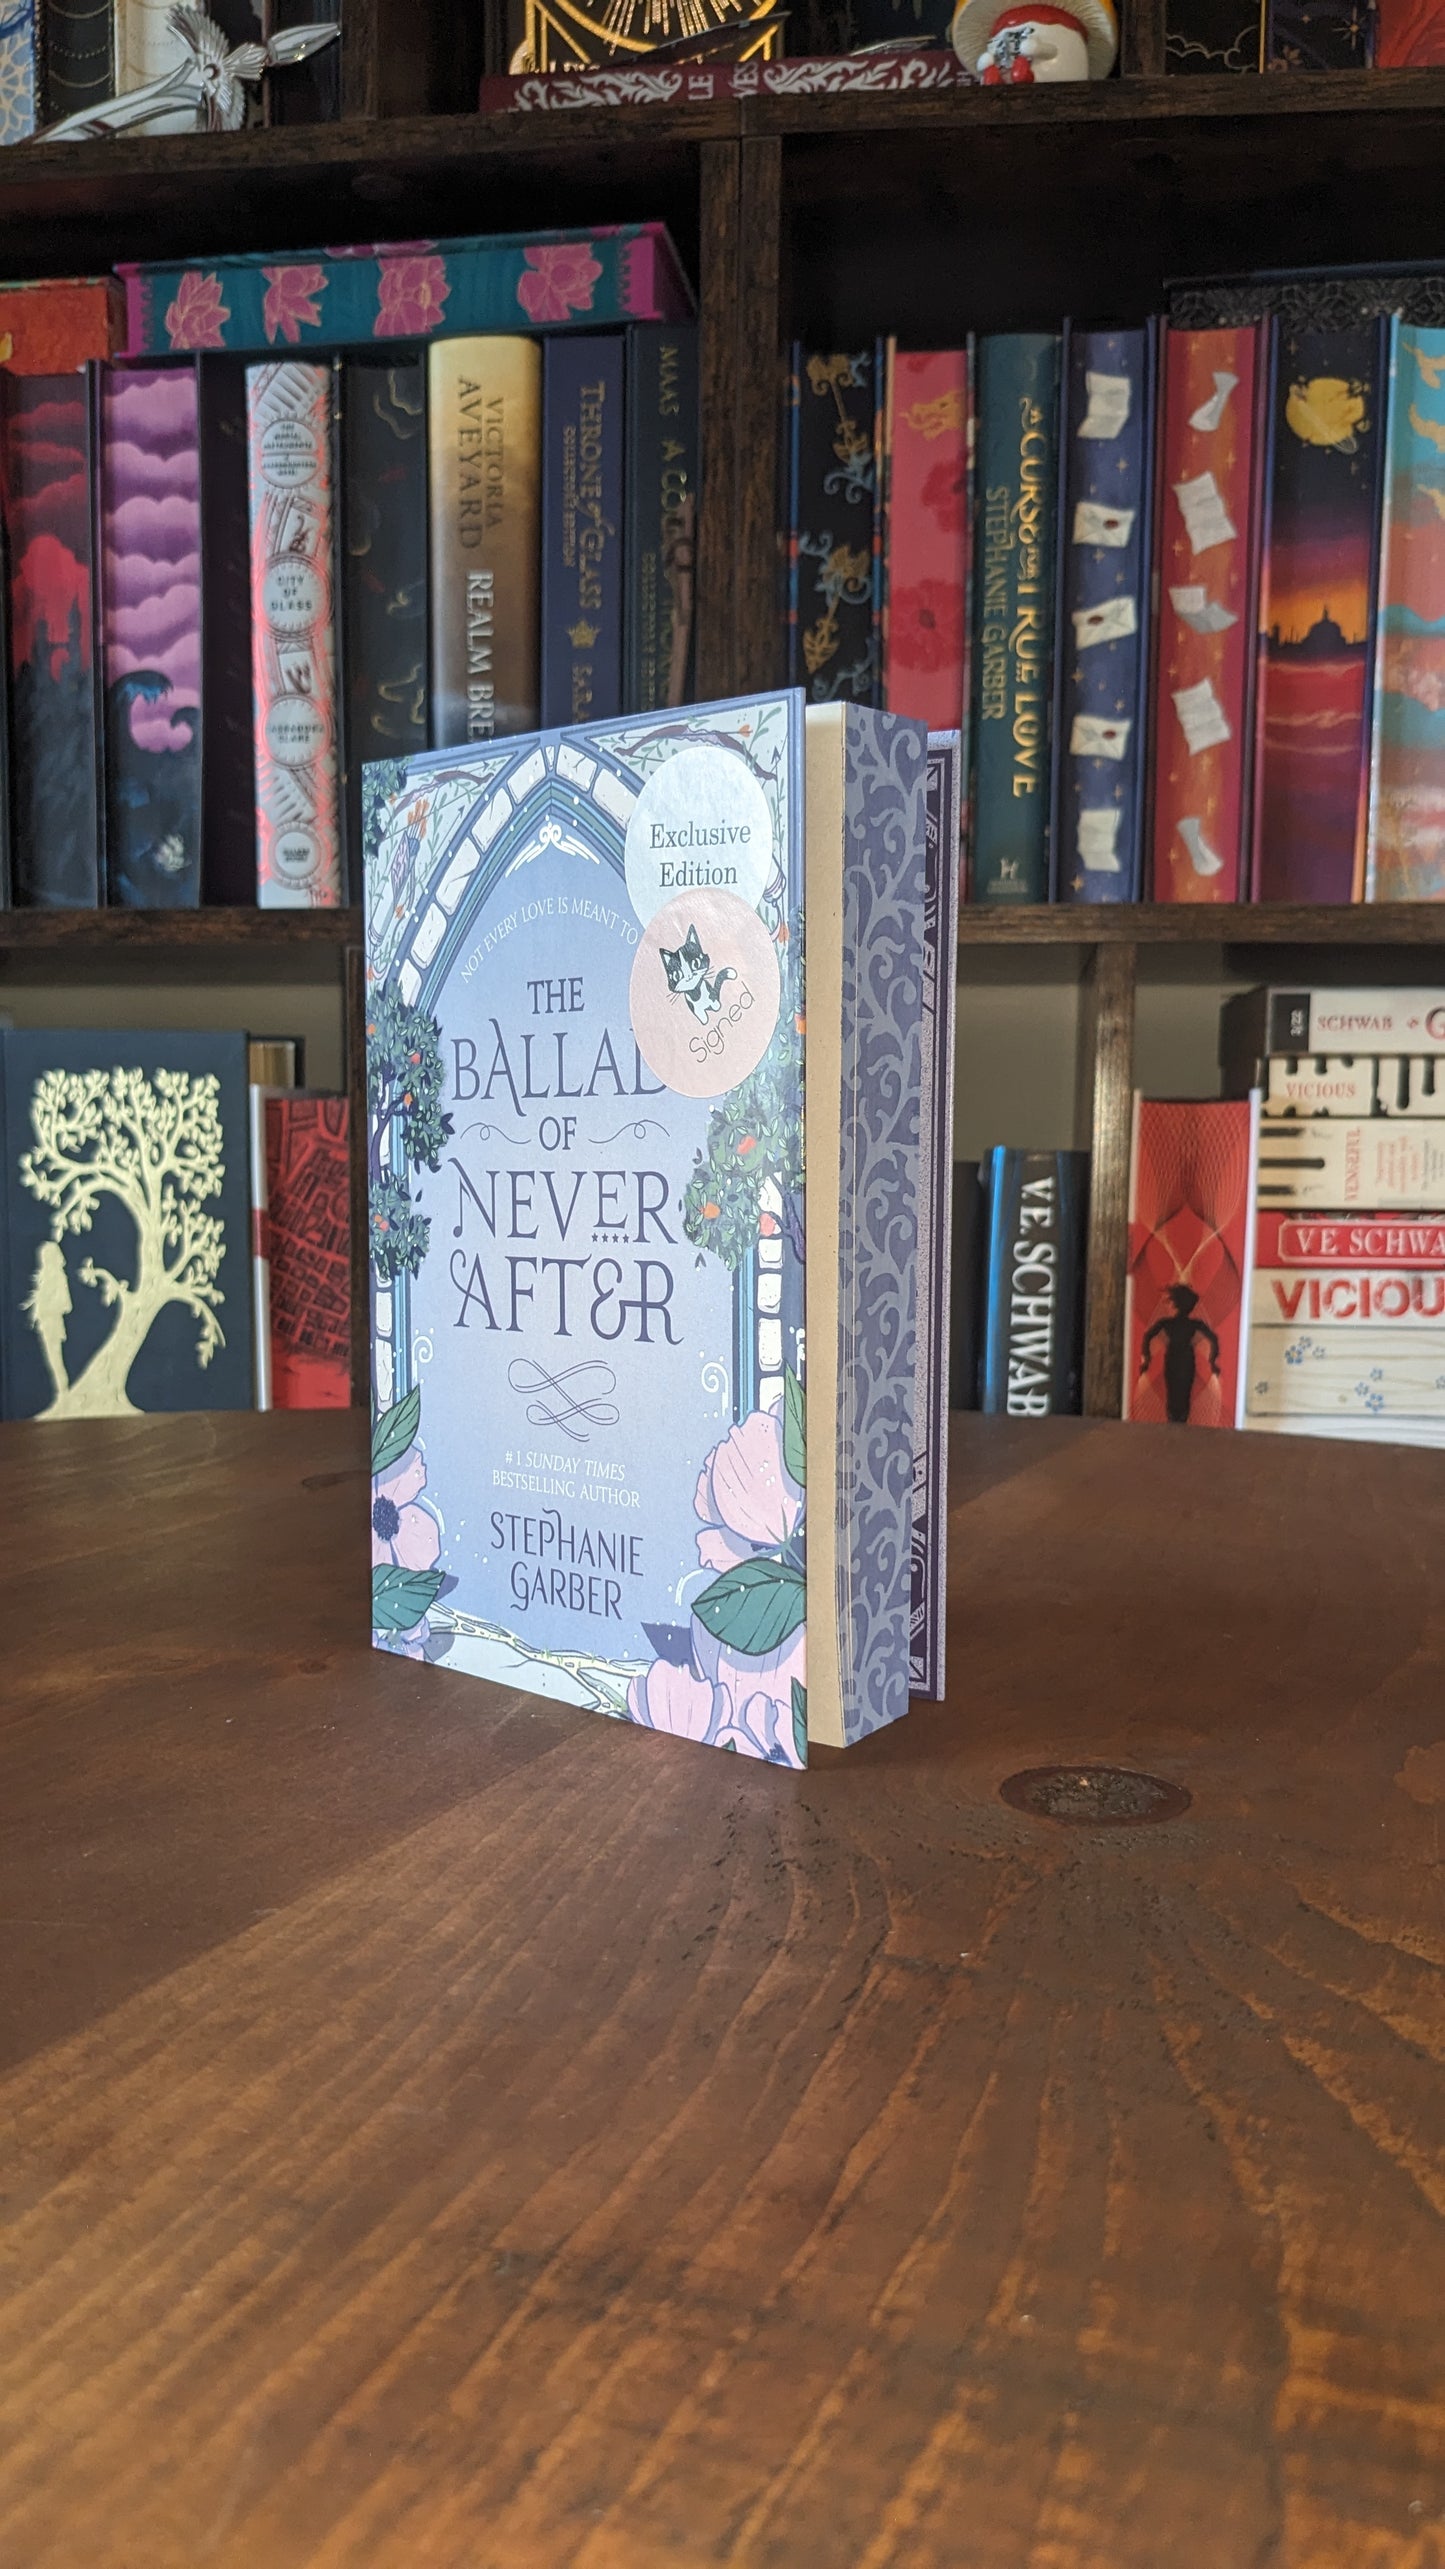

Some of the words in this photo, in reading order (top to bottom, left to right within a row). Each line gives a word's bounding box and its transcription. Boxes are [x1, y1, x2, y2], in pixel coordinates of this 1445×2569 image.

[457, 376, 483, 549] AVEYARD
[485, 396, 504, 528] VICTORIA
[580, 381, 606, 498] THRONE
[579, 526, 605, 609] GLASS
[985, 486, 1018, 616] STEPHANIE
[467, 570, 494, 674] REALM
[467, 682, 494, 742] BRE
[981, 623, 1008, 721] GARBER
[1013, 691, 1042, 798] LOVE
[650, 820, 752, 849] Exclusive
[659, 860, 738, 888] Edition
[460, 945, 485, 984] NOT
[484, 912, 519, 953] EVERY
[521, 898, 554, 923] LOVE
[558, 896, 568, 914] IS
[571, 898, 620, 930] MEANT
[620, 920, 639, 945] TO
[527, 977, 585, 1015] THE
[688, 981, 756, 1063] Signed
[1317, 1015, 1393, 1032] SCHWAB
[1285, 1083, 1357, 1098] VICIOUS
[539, 1116, 577, 1151] OF
[447, 1157, 678, 1244] NEVER
[449, 1249, 684, 1345] AFTER
[1006, 1241, 1057, 1417] SCHWAB
[492, 1469, 575, 1498] BESTSELLING
[580, 1483, 640, 1508] AUTHOR
[525, 1451, 581, 1474] SUNDAY
[584, 1459, 625, 1481] TIMES
[491, 1507, 644, 1577] STEPHANIE
[510, 1561, 622, 1620] GARBER
